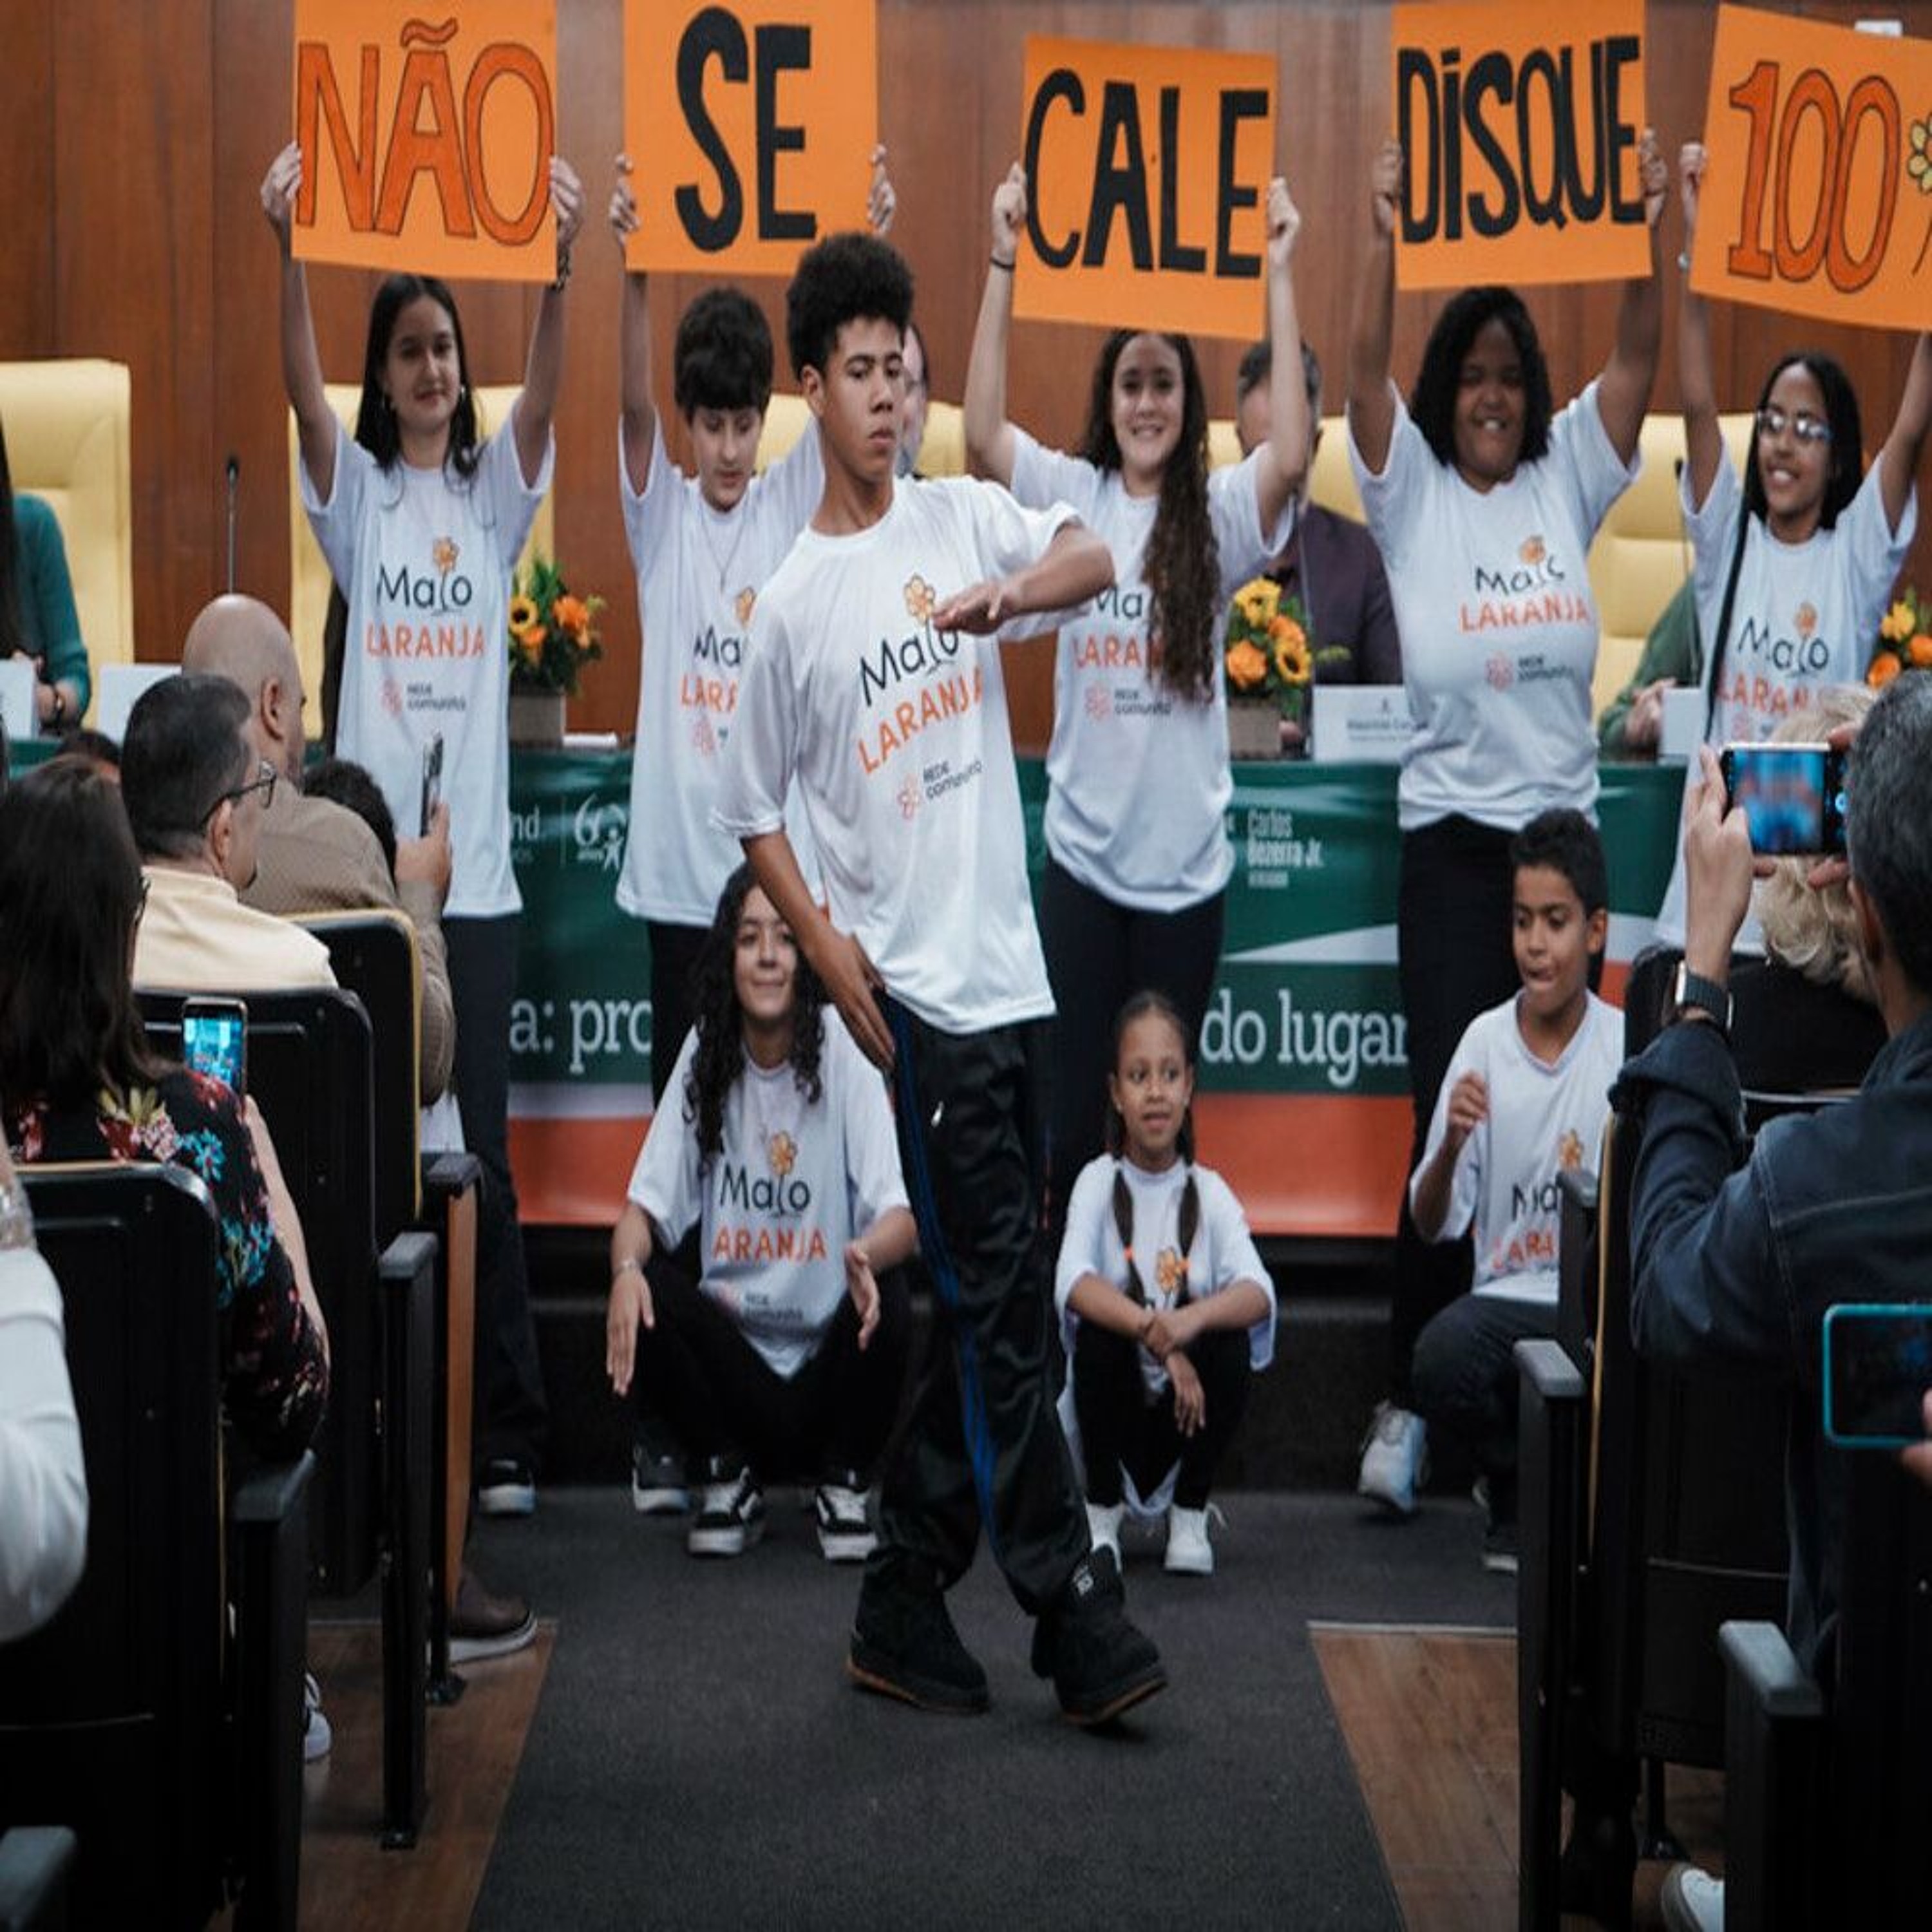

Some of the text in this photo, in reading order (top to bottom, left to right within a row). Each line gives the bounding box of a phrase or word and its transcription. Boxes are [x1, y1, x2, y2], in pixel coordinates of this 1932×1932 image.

[297, 17, 555, 247] NÃO
[675, 6, 817, 253] SE
[1025, 69, 1268, 278] CALE
[1728, 61, 1901, 293] 100
[365, 621, 486, 658] LARANJA
[1200, 989, 1266, 1063] do
